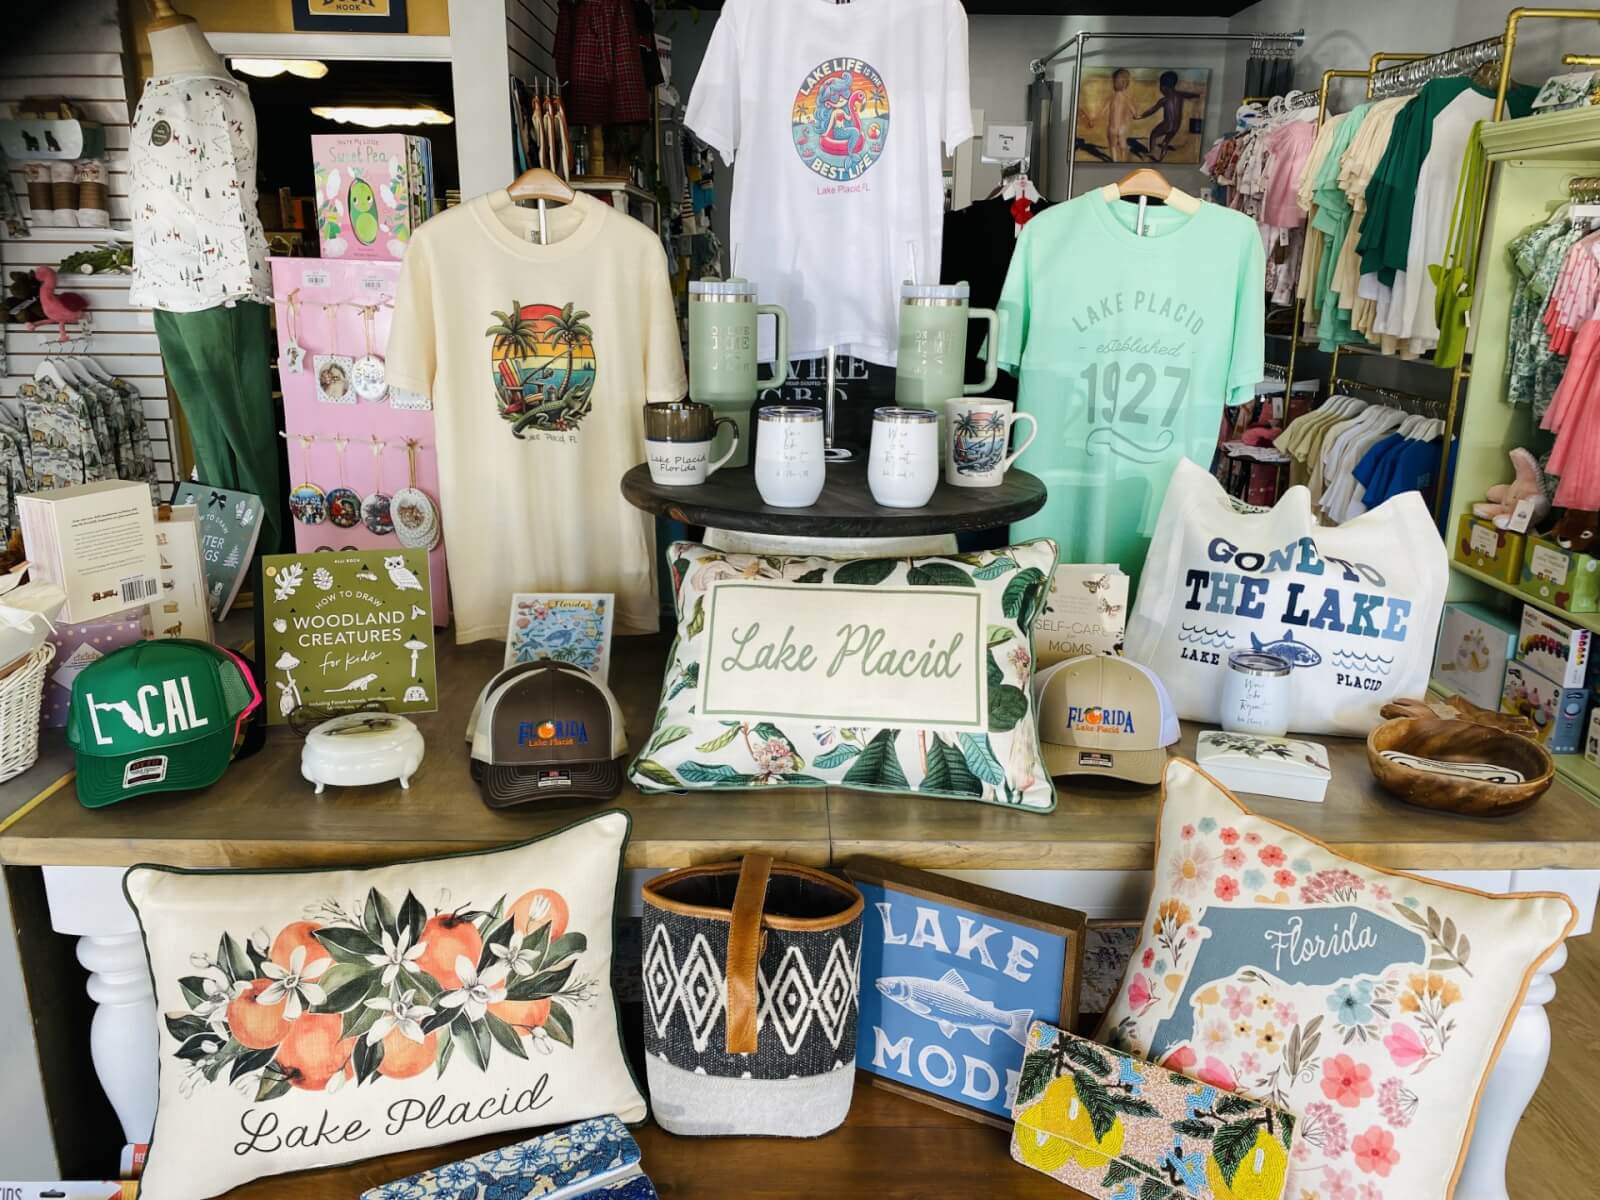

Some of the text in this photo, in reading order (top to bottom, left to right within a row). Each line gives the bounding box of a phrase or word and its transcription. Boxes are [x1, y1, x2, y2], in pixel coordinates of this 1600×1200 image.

[799, 61, 833, 96] LAKE
[833, 58, 865, 74] LIFE
[365, 146, 387, 162] Pea
[811, 153, 874, 181] BEST LIFE
[816, 185, 836, 196] Lake
[1071, 289, 1205, 336] LAKE PLACID
[1096, 335, 1187, 358] established
[1079, 360, 1192, 428] 1927
[660, 463, 697, 473] Florida
[674, 452, 707, 465] Placid
[1207, 536, 1387, 588] GONE TO
[314, 590, 383, 611] HOW TO DRAW
[1184, 568, 1413, 642] THE LAKE
[293, 610, 406, 631] WOODLAND
[297, 627, 403, 648] CREATURES
[1047, 639, 1094, 656] MOMS
[319, 649, 383, 676] for kids
[721, 621, 964, 681] Lake Placid
[1180, 646, 1221, 667] LAKE
[1335, 672, 1384, 693] PLACID
[1096, 724, 1121, 735] Placid
[874, 901, 1041, 983] LAKE
[1263, 911, 1378, 972] Florida
[232, 1072, 554, 1157] Lake Placid
